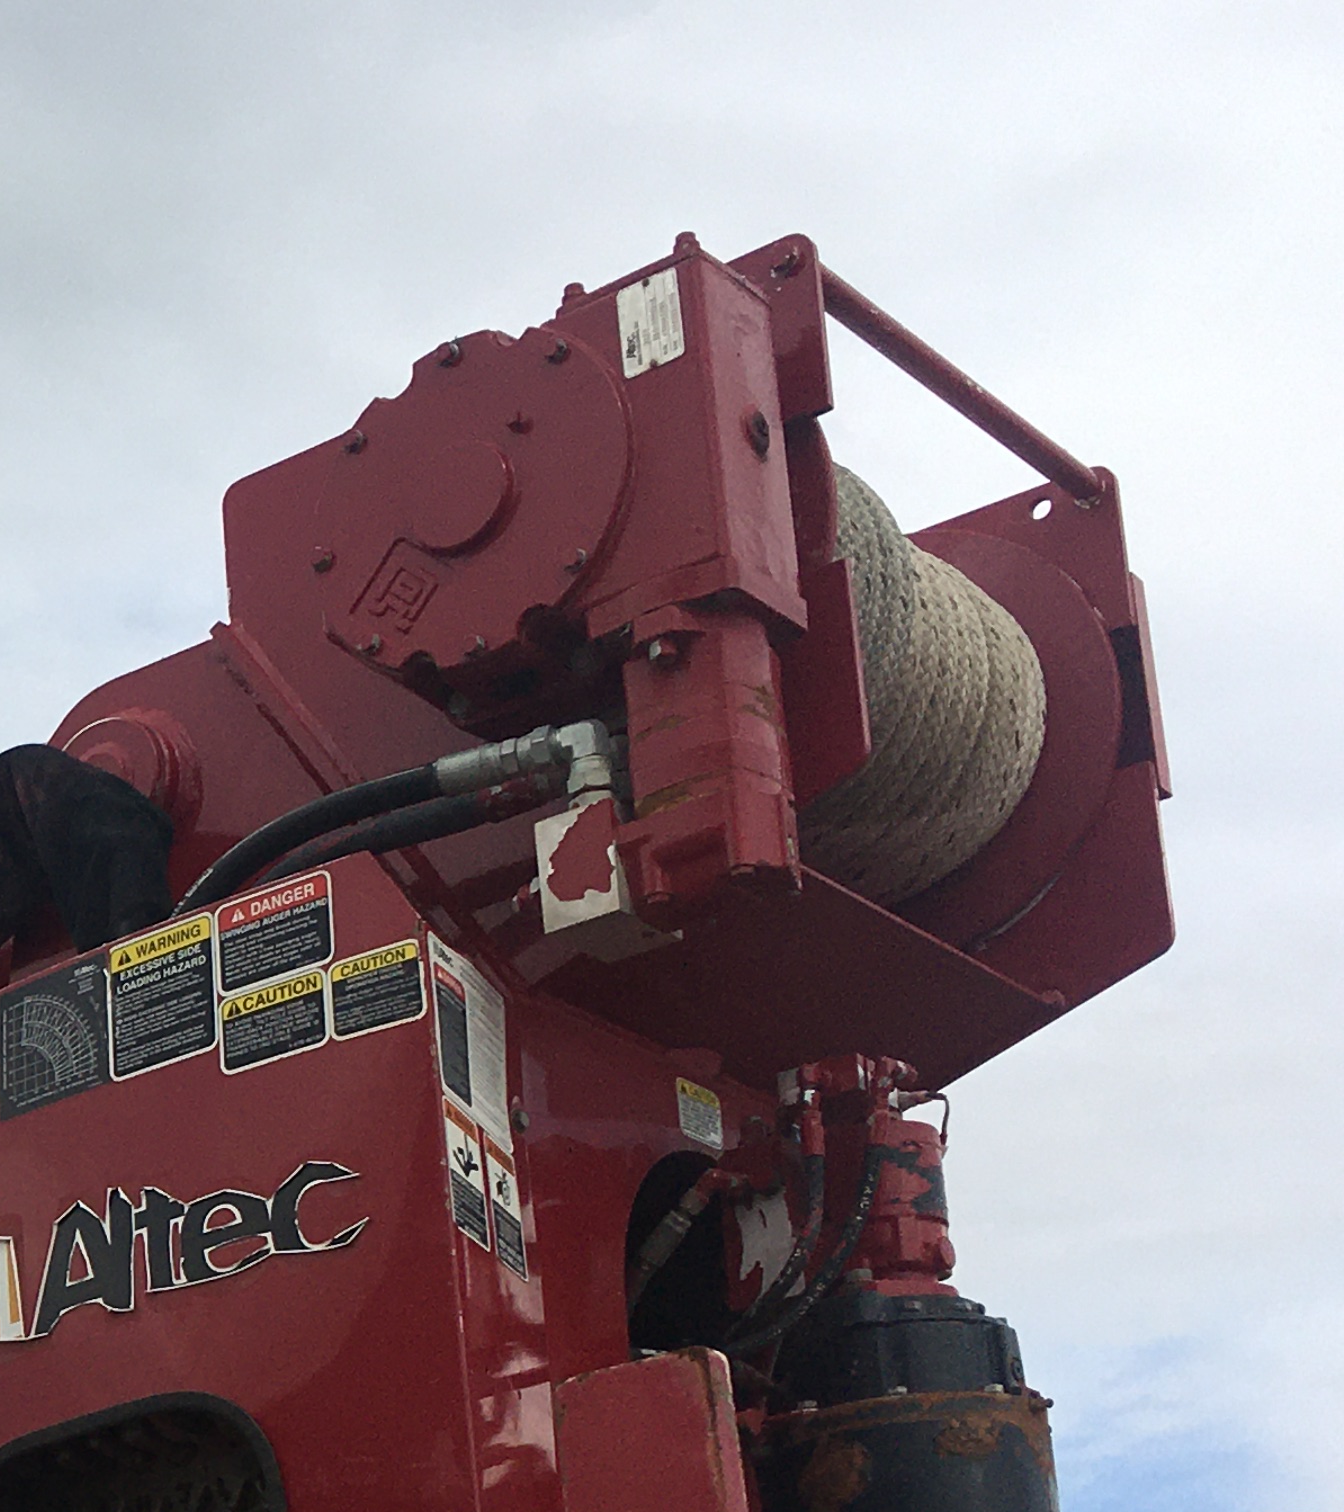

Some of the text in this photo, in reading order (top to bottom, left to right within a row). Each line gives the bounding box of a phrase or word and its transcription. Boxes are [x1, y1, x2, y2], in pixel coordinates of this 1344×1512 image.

[250, 883, 315, 916] DANGER
[262, 908, 291, 926] AUGER
[292, 897, 327, 916] HAZARD
[135, 924, 201, 958] WARNING
[116, 955, 207, 995] LOADING HAZARD
[120, 943, 201, 981] EXCESSIVE SIDE
[340, 948, 406, 977] CAUTION
[243, 976, 318, 1011] CAUTION
[34, 1161, 368, 1337] Altec
